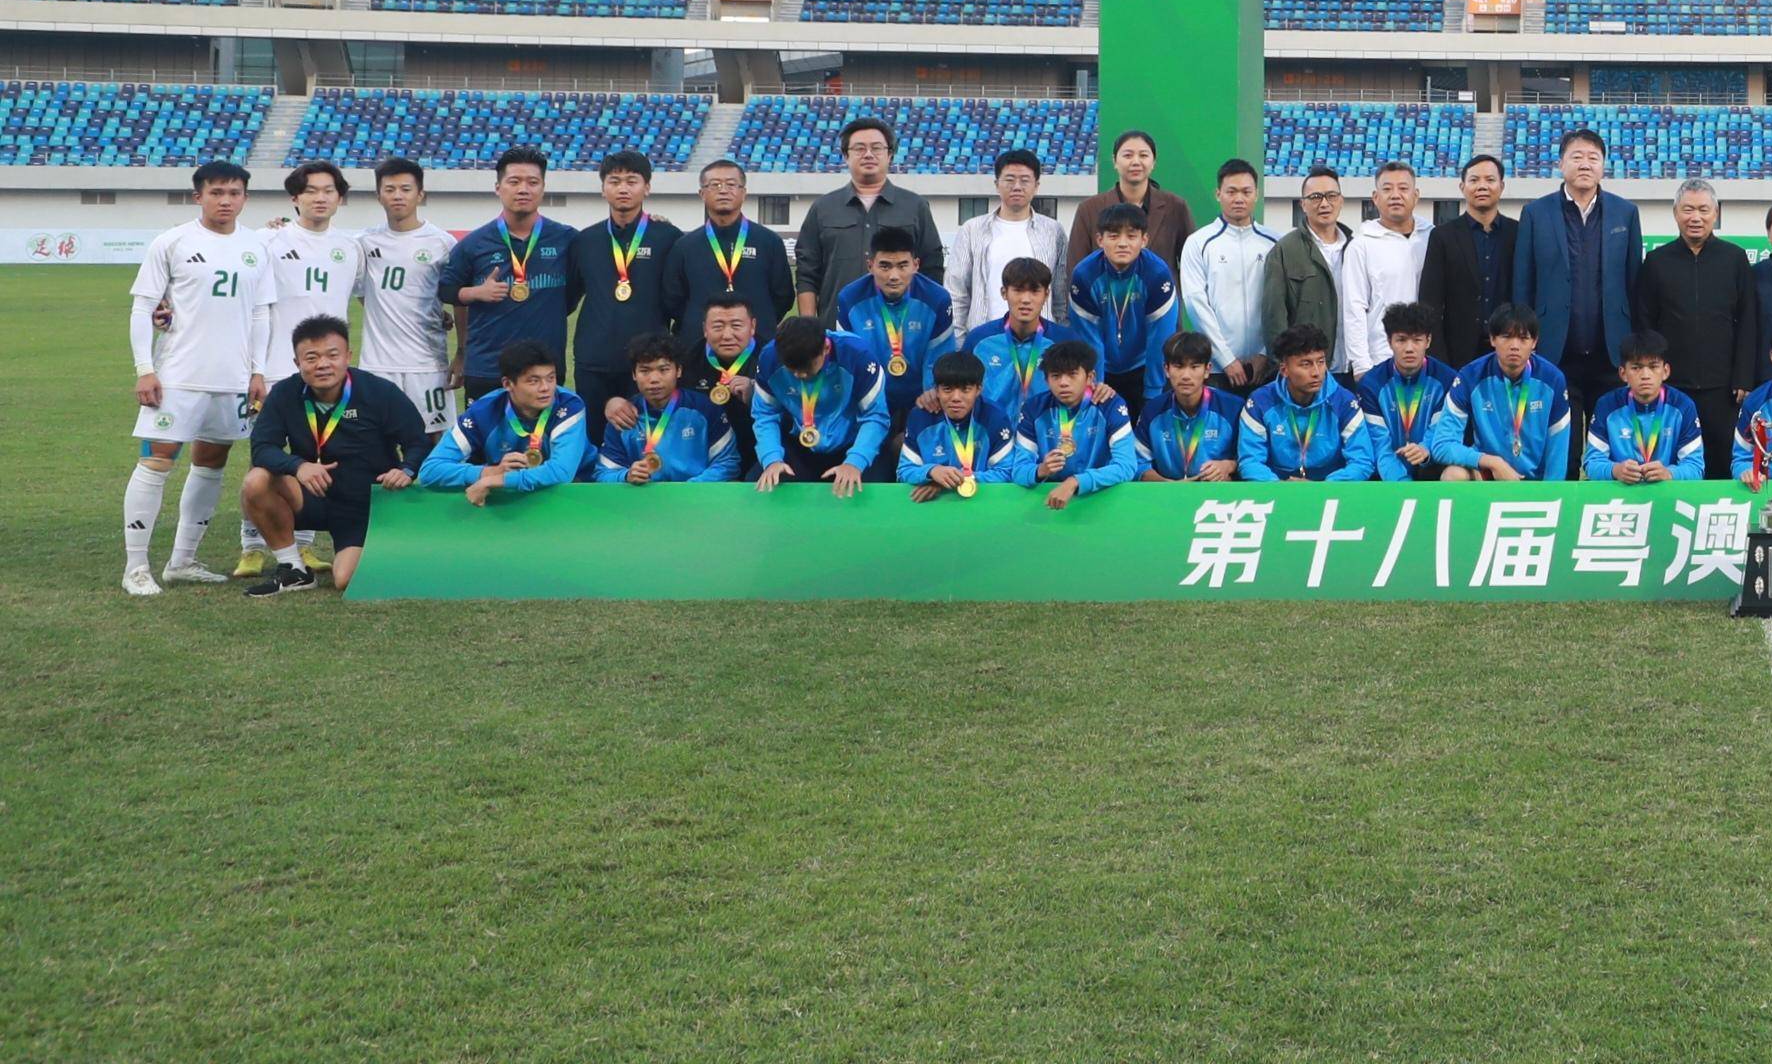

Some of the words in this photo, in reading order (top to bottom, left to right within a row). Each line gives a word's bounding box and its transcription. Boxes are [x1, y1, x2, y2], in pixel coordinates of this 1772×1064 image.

[541, 247, 557, 256] SZFA
[637, 247, 651, 256] SZFA
[212, 270, 238, 297] 21
[305, 266, 328, 293] 14
[381, 266, 405, 291] 10
[425, 387, 446, 414] 10
